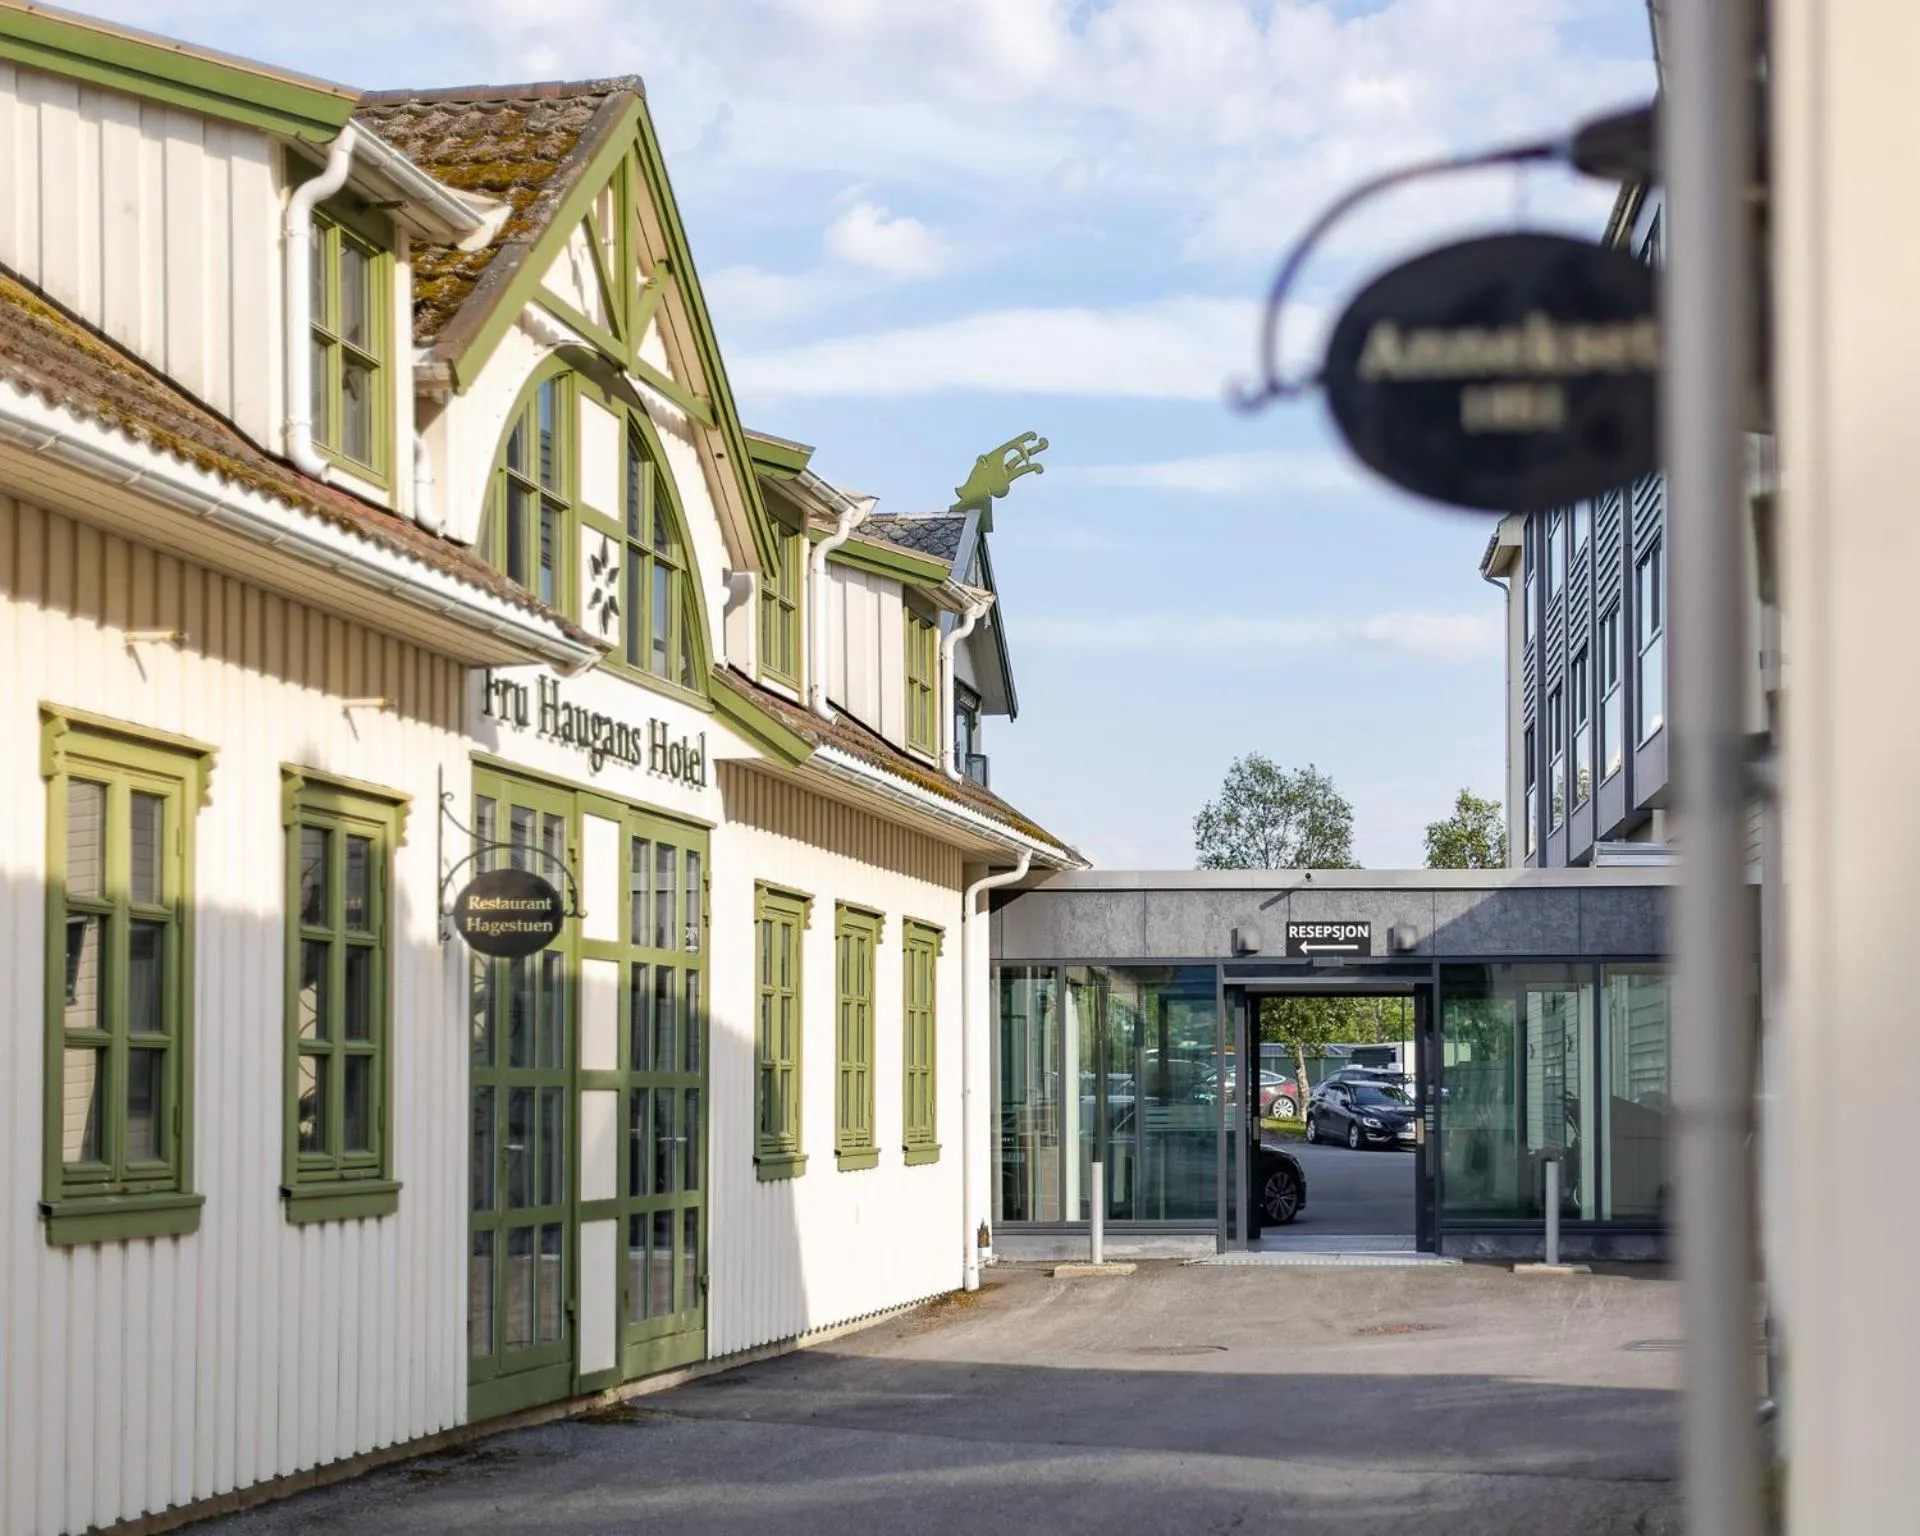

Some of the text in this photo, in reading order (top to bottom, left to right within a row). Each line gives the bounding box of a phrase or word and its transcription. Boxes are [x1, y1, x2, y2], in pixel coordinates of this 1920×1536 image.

[483, 668, 707, 788] Fru Haugans Hotel
[468, 895, 552, 910] Restaurant
[467, 917, 553, 936] Hagestuen
[1288, 925, 1369, 941] RESEPSJON
